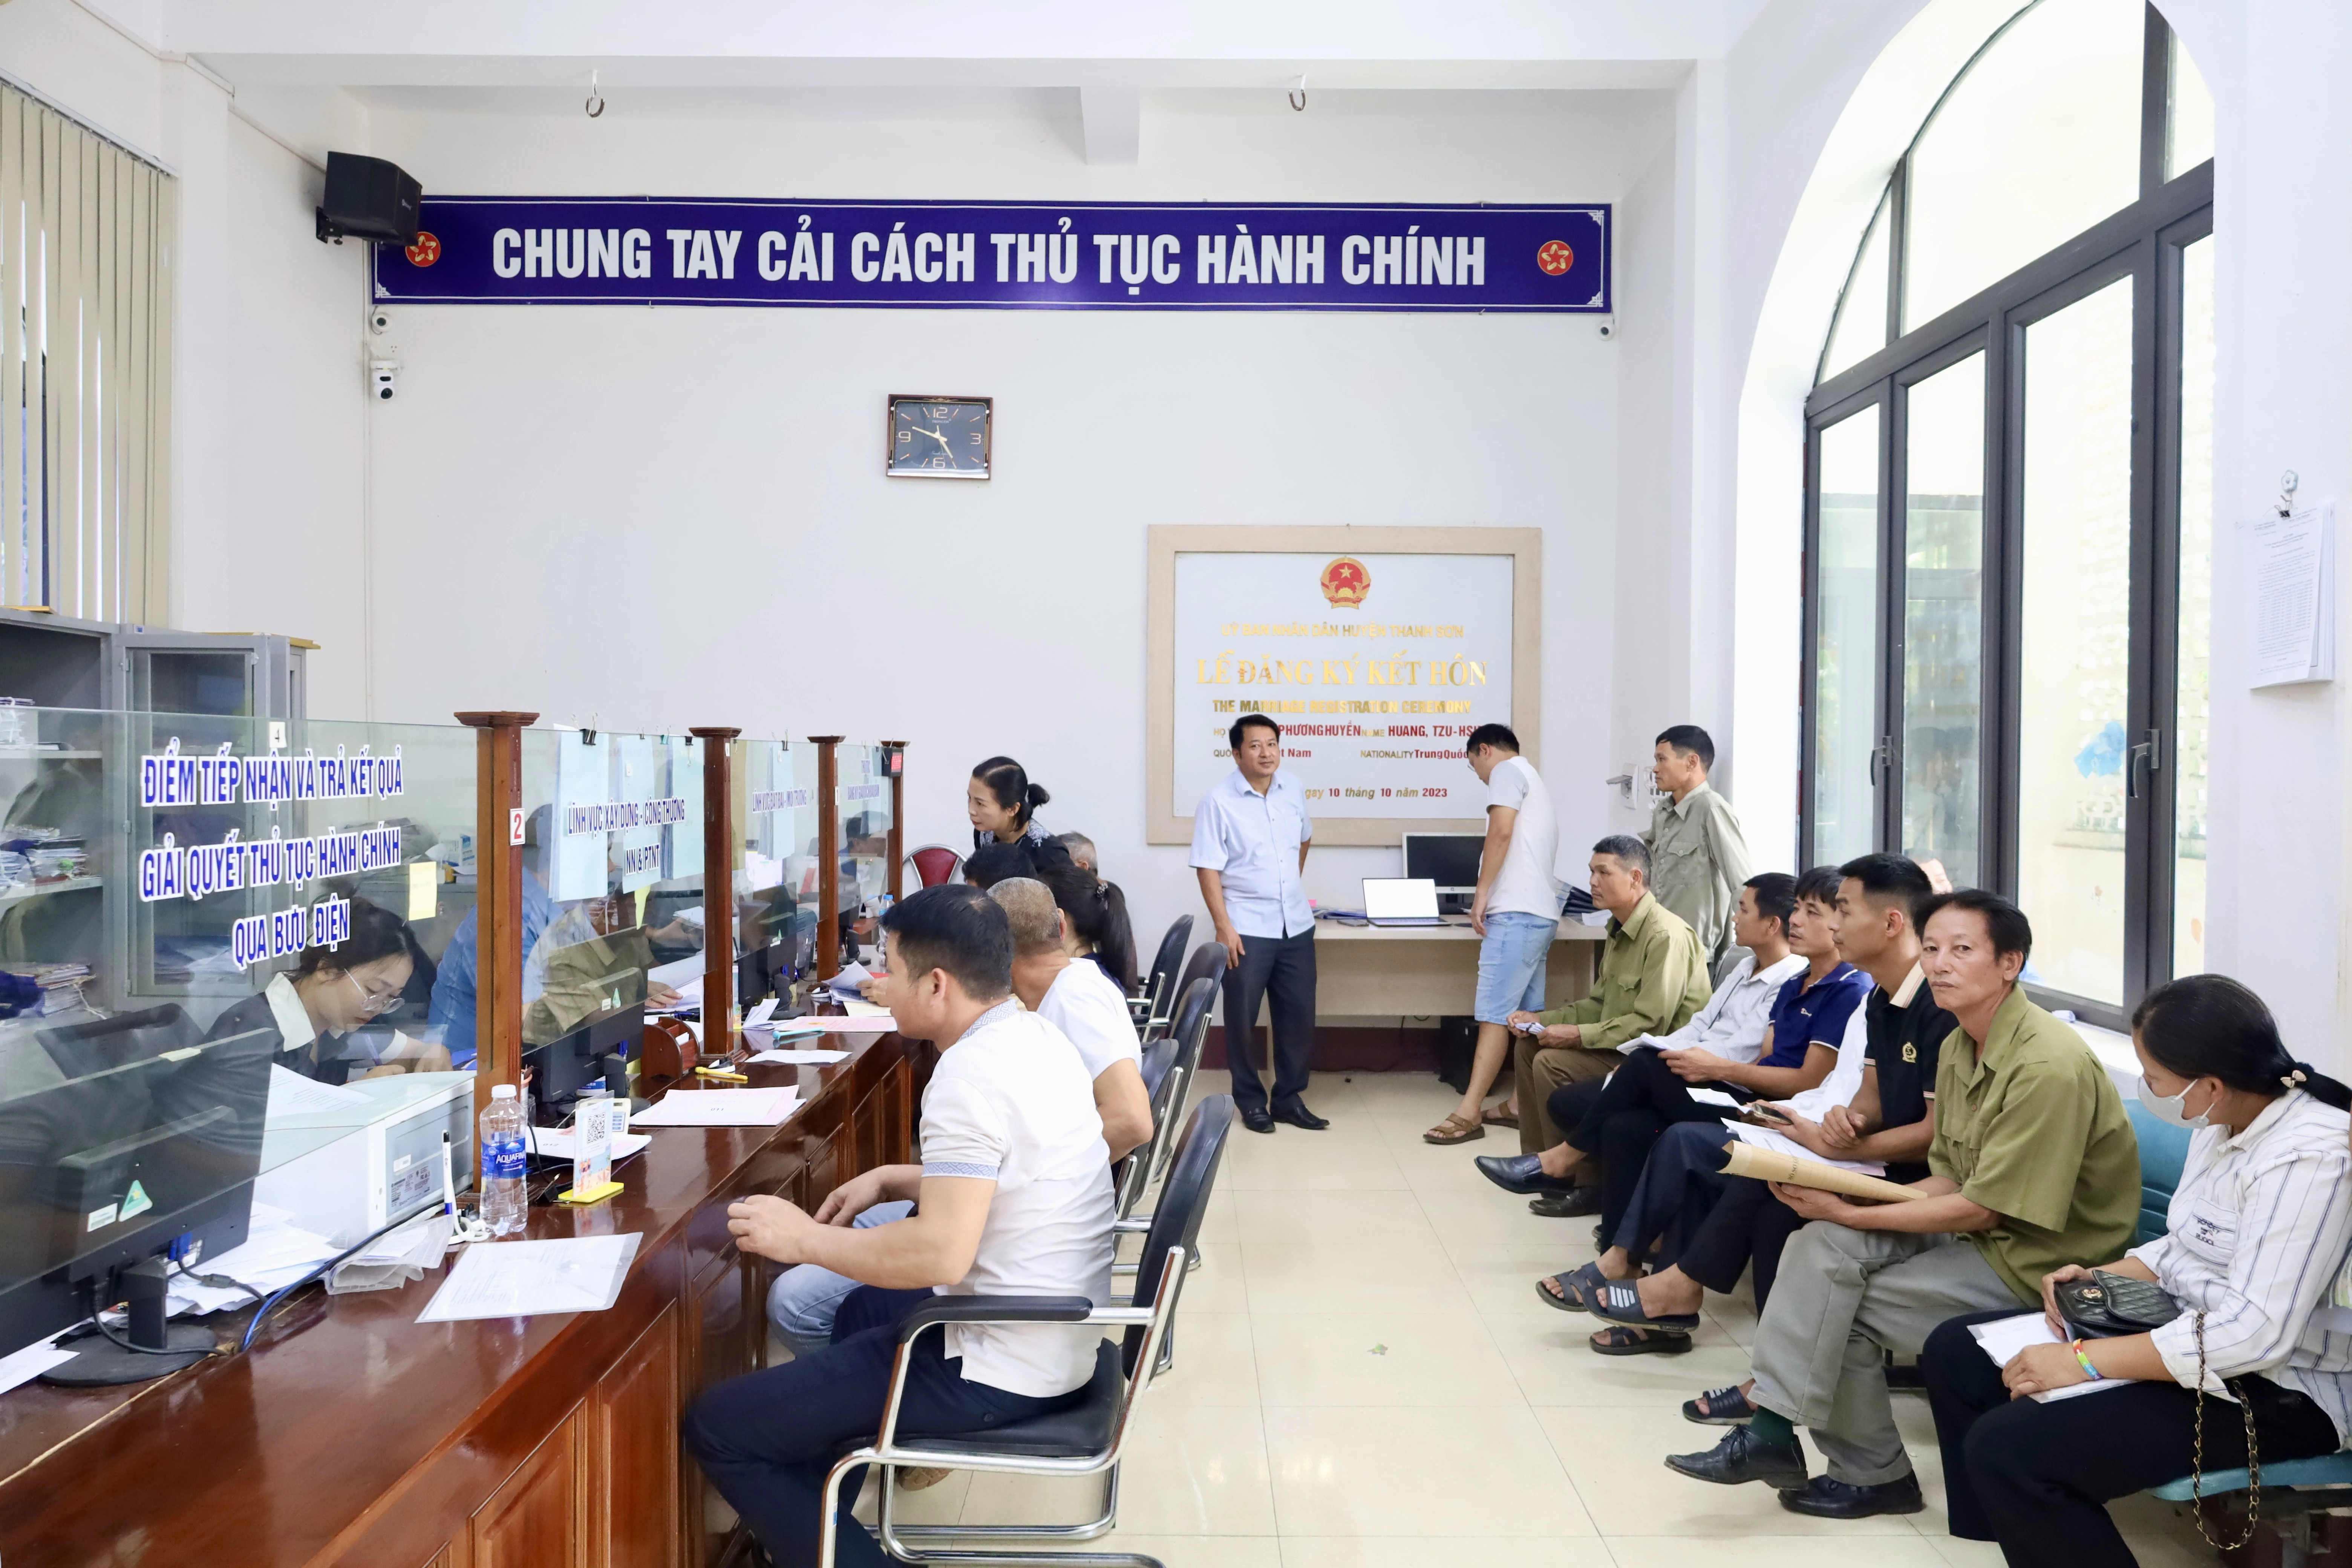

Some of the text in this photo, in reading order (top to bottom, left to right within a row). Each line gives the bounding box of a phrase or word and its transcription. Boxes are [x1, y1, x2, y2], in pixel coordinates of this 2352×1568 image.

[493, 214, 1485, 295] CHUNG TAY CẢI CÁCH THỦ TỤC HÀNH CHÍNH
[933, 407, 948, 418] 12
[898, 431, 911, 443] 9
[969, 433, 982, 444] 3
[933, 457, 946, 469] 6
[1242, 624, 1269, 636] BAN
[1272, 622, 1308, 636] NHÂN
[1312, 622, 1338, 636] DÂN
[1343, 621, 1386, 640] HUYỆN
[1389, 625, 1433, 637] THANH
[1436, 625, 1464, 637] SƠN
[1196, 649, 1488, 686] LỄ ĐĂNG KÝ KẾT HÔN
[1213, 700, 1471, 714] THE MARRIAGE REGISTRATION CEREMONY
[1213, 728, 1225, 738] HỌ
[1361, 729, 1385, 737] NAME
[1388, 725, 1428, 738] HUANG,
[1288, 748, 1311, 758] Nam
[1360, 750, 1413, 759] NATIONALITY
[144, 737, 403, 810] ĐIỂM TIẾP NHẬN VÀ TRẢ KẾT QUẢ
[1328, 788, 1340, 797] 10
[1345, 786, 1375, 799] tháng
[1380, 788, 1392, 797] 10
[1396, 787, 1418, 797] năm
[1422, 788, 1447, 797] 2023
[568, 802, 586, 834] LĨNH
[588, 803, 603, 838] VỰC
[605, 798, 619, 831] XÂY
[620, 800, 639, 834] DỰNG
[645, 795, 661, 825] CÔNG
[514, 813, 522, 839] 2
[142, 822, 400, 899] GIẢI QUYẾT THỦ TỤC HÀNH CHÍNH
[626, 844, 659, 874] NN & PTNT
[235, 894, 349, 968] QUA BƯU ĐIỆN
